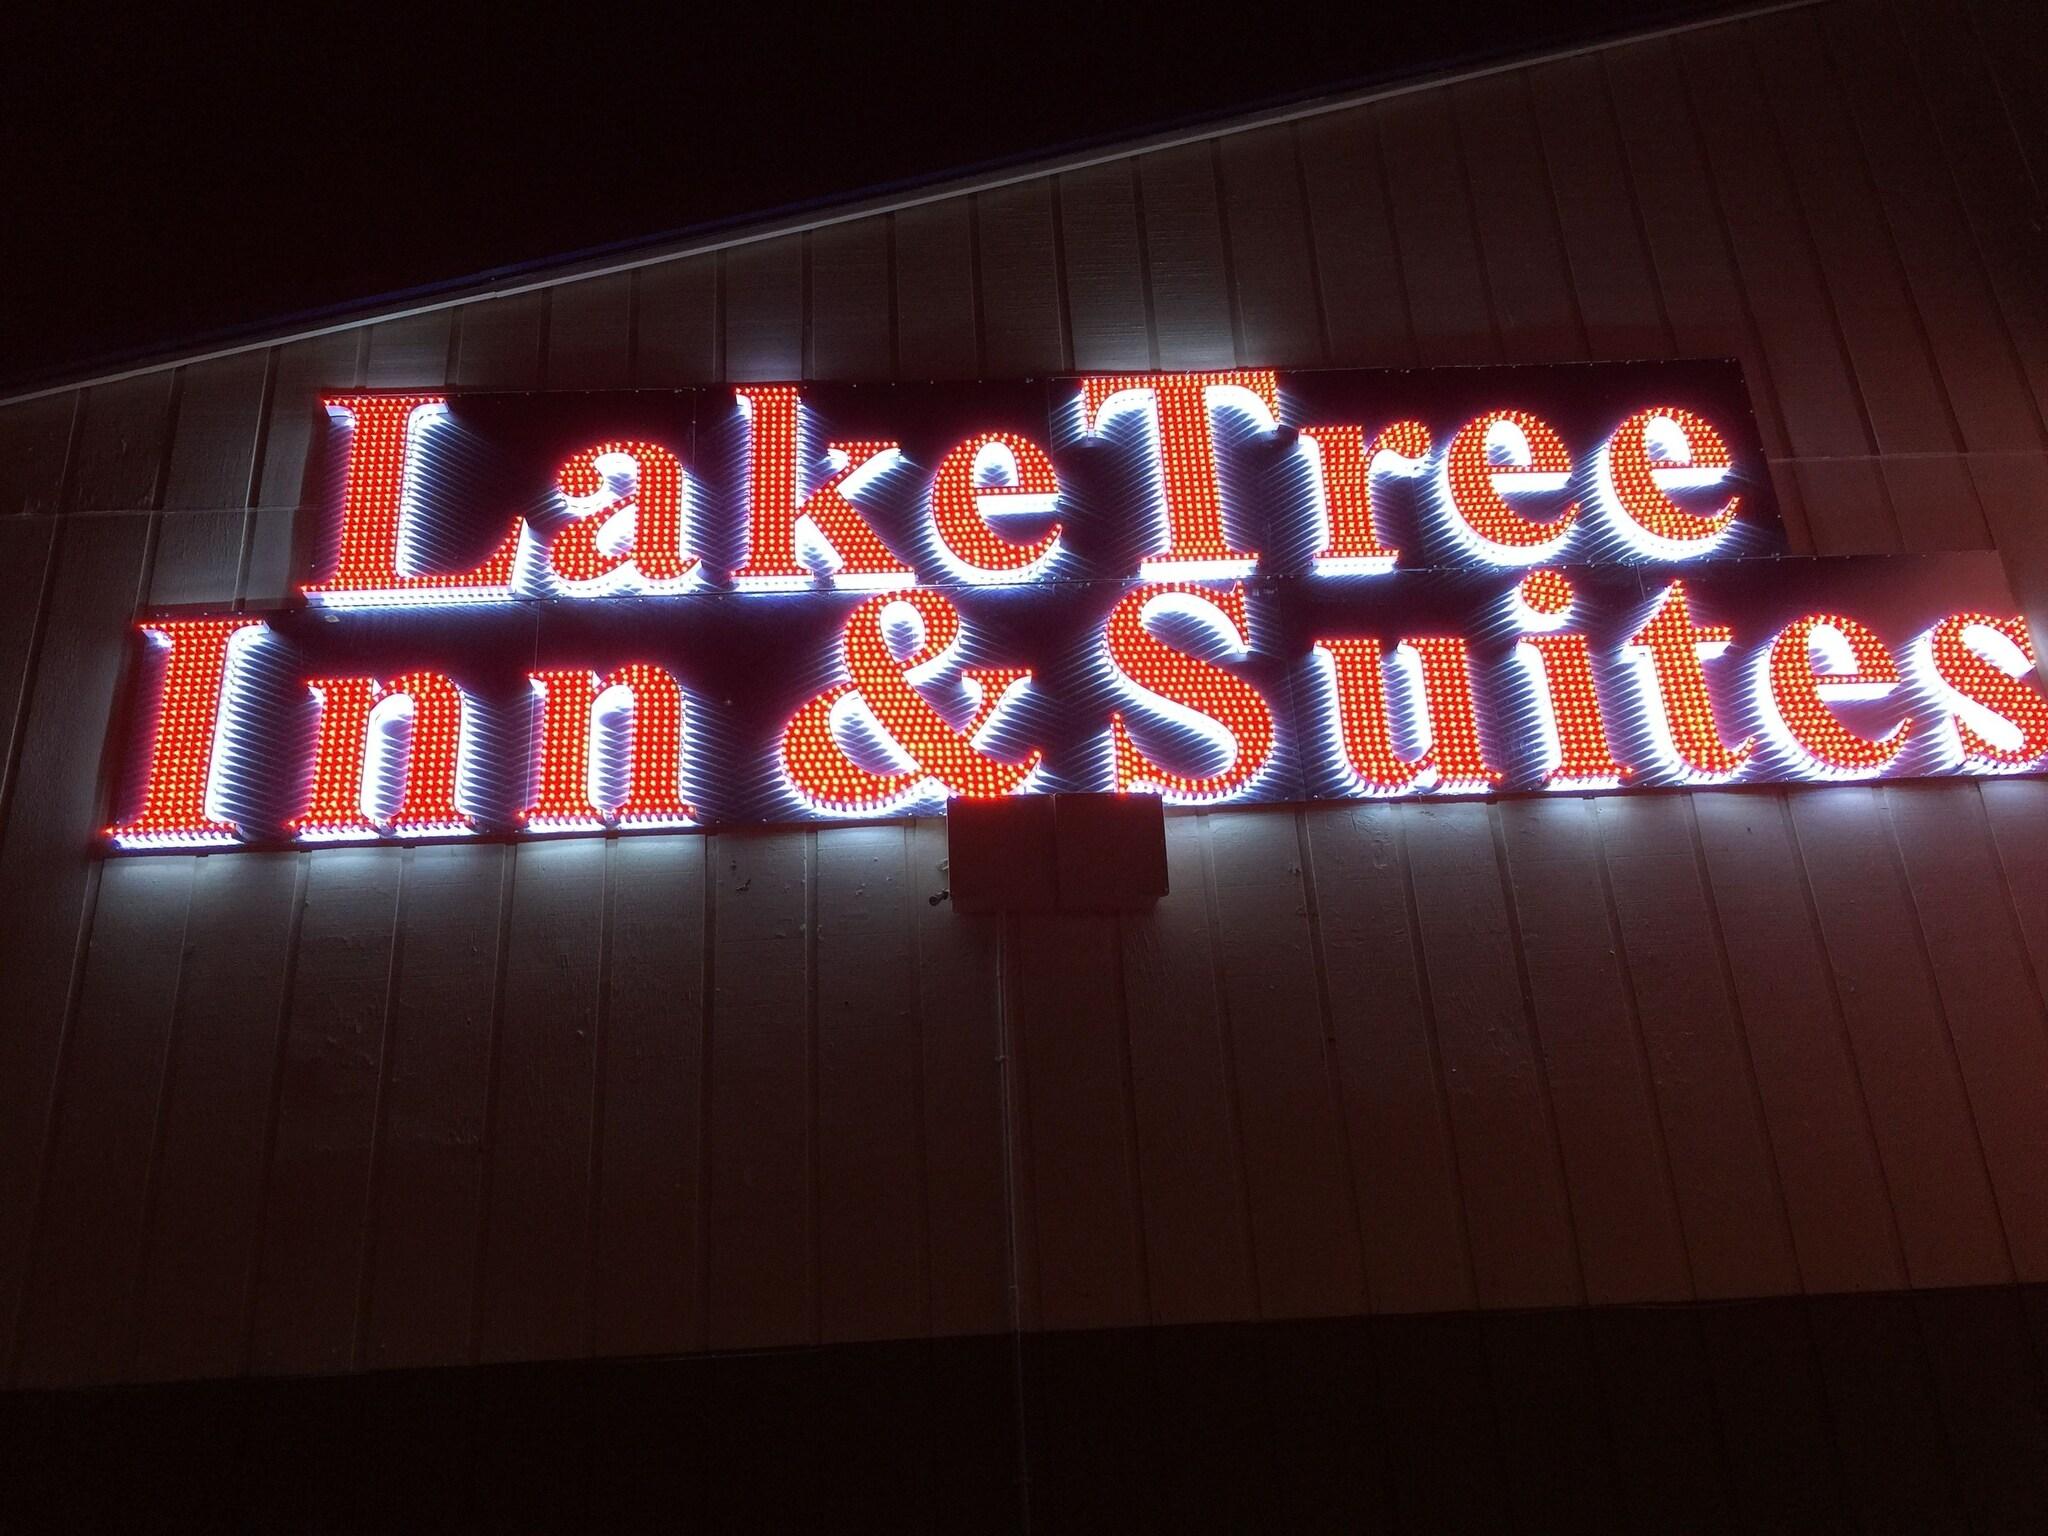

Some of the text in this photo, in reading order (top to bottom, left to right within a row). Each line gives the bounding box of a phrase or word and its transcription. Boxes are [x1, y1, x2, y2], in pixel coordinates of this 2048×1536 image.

[105, 568, 2048, 848] Inn & Suites
